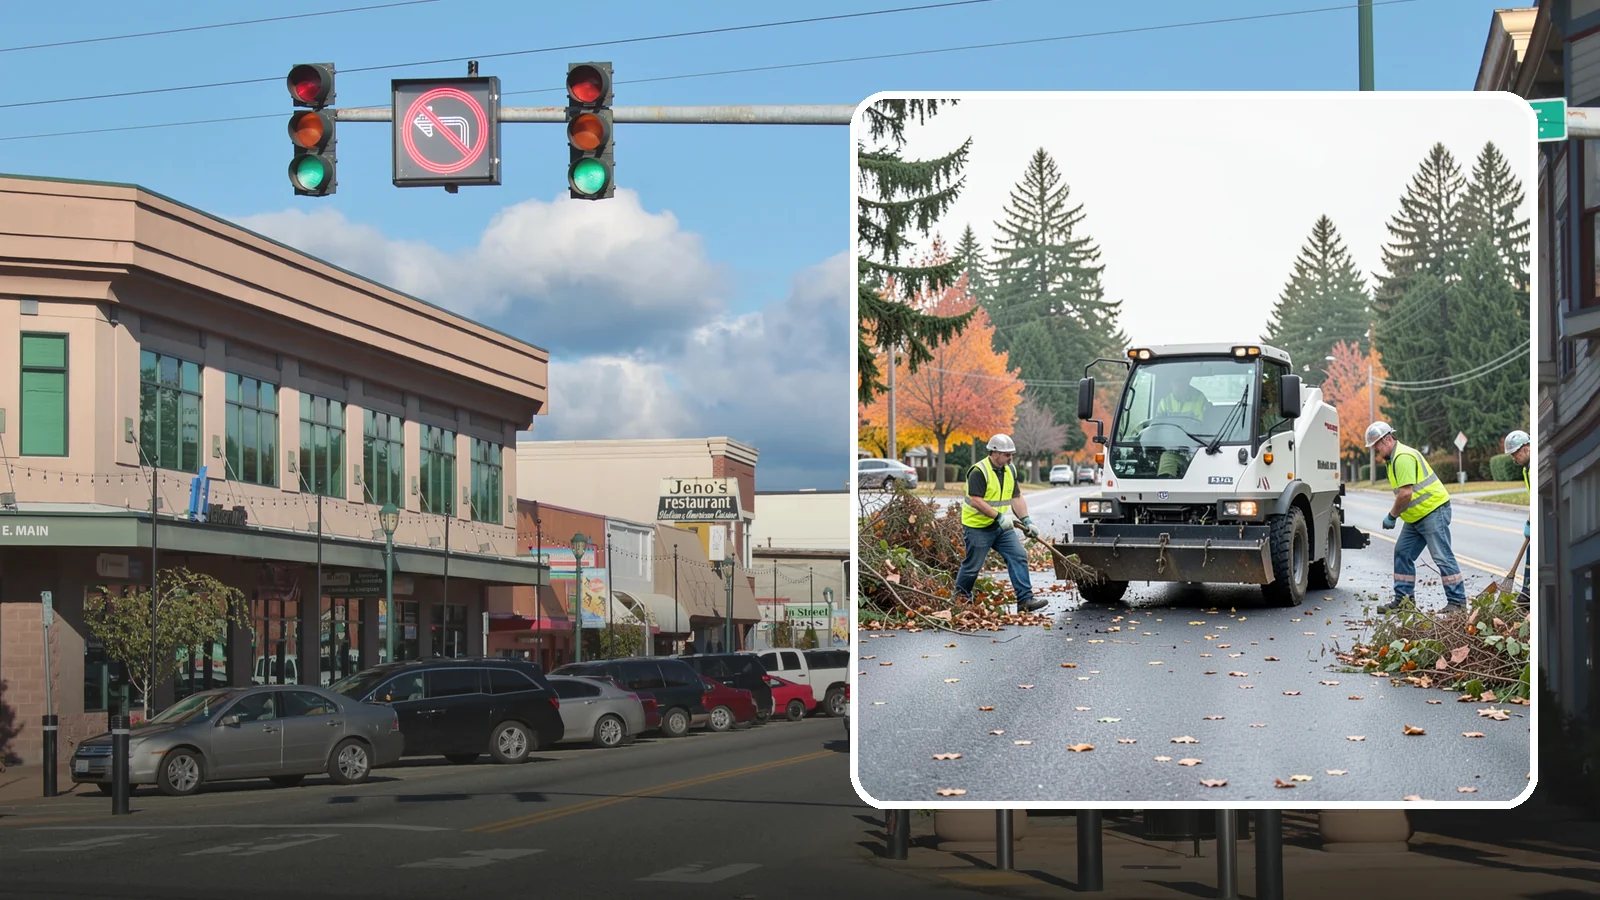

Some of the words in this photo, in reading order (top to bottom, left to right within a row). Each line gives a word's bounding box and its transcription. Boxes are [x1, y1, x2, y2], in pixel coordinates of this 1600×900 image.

[670, 480, 727, 494] Jeno's
[665, 496, 731, 509] restaurant
[659, 510, 681, 519] Italian
[686, 510, 714, 519] American
[715, 509, 737, 519] Cuisine
[2, 525, 13, 536] E.
[15, 525, 49, 536] MAIN
[798, 608, 828, 616] Street
